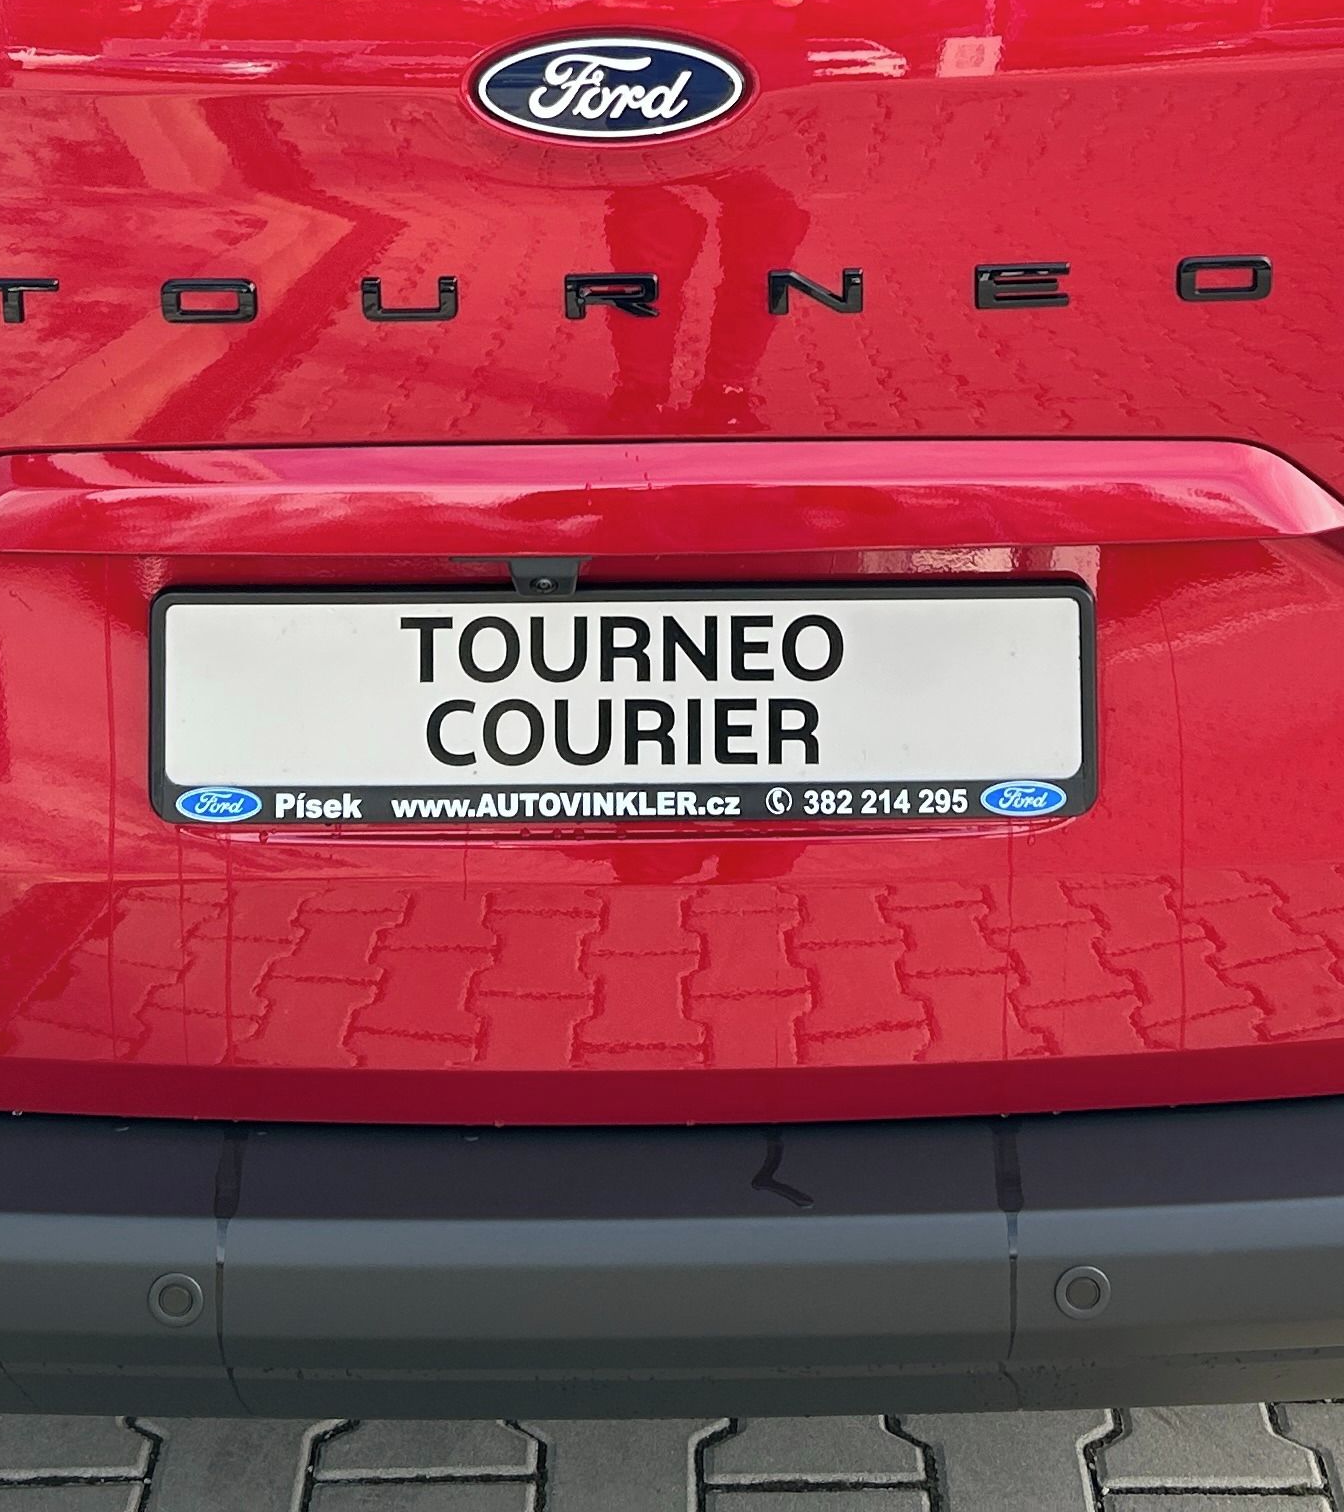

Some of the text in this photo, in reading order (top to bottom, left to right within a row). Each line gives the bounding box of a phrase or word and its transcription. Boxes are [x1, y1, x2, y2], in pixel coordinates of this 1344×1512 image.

[529, 54, 692, 119] Ford
[400, 614, 844, 683] TOURNEO
[426, 698, 819, 766] COURIER
[275, 792, 362, 819] Písek
[391, 791, 741, 819] www.AUTOVINKLER.cz
[803, 789, 853, 815] 382
[861, 789, 910, 815] 214
[918, 788, 968, 814] 295
